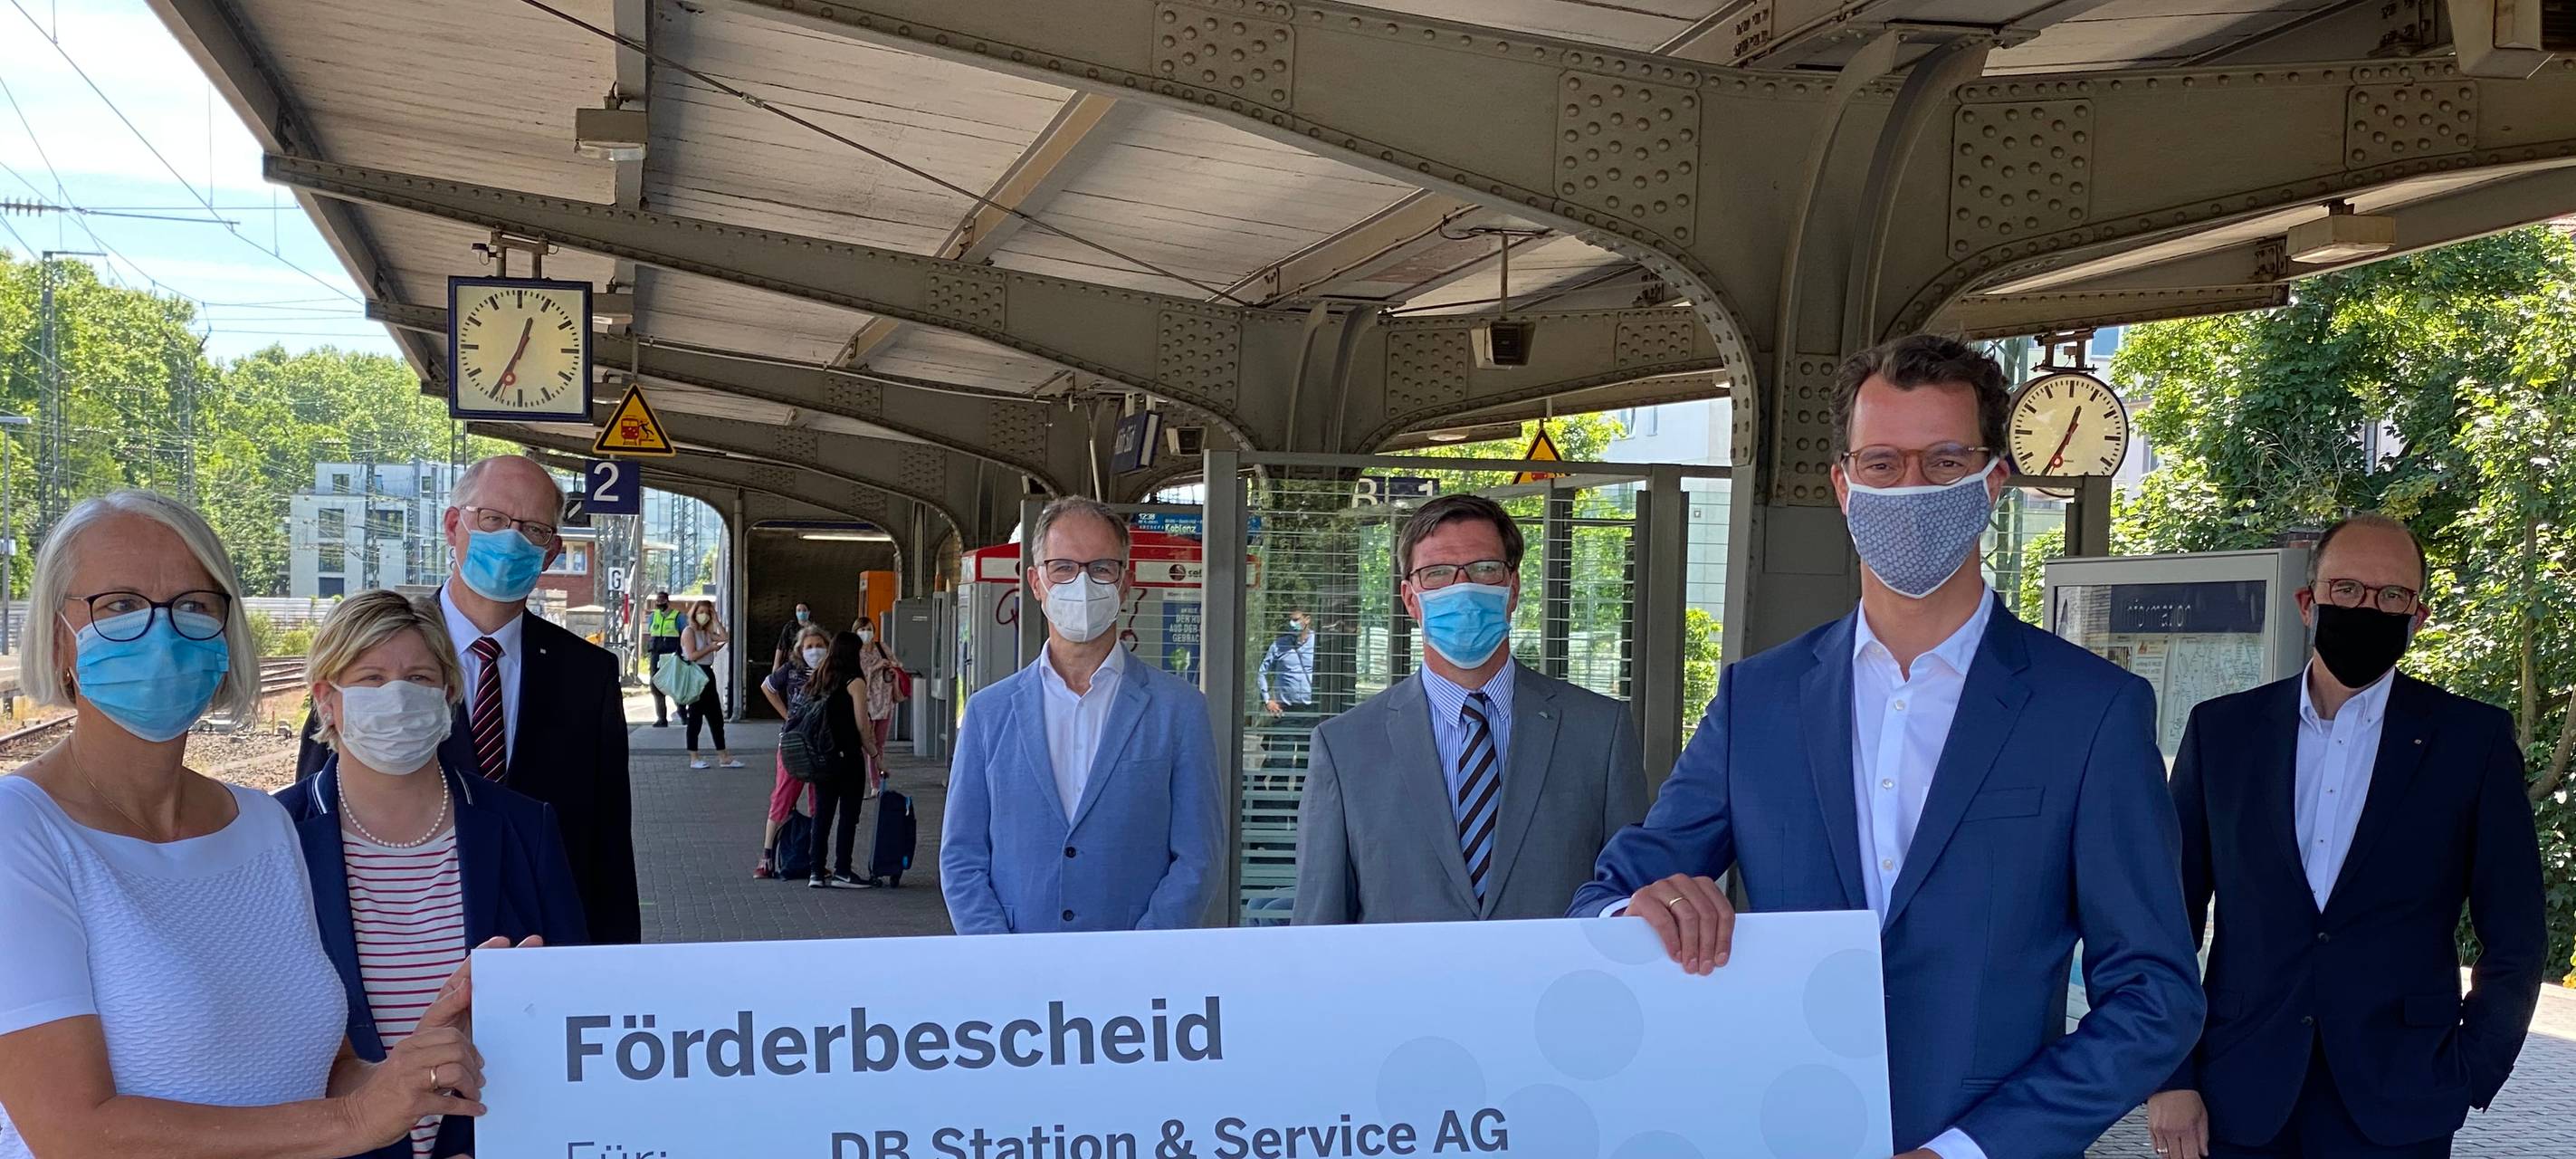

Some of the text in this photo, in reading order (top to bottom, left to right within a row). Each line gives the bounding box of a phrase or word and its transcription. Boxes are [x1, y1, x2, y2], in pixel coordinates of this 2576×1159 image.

[593, 462, 619, 502] 2
[1164, 523, 1197, 534] Koblenz
[611, 570, 621, 589] G
[566, 996, 1224, 1082] Förderbescheid
[831, 1107, 1509, 1159] DB Station & Service AG
